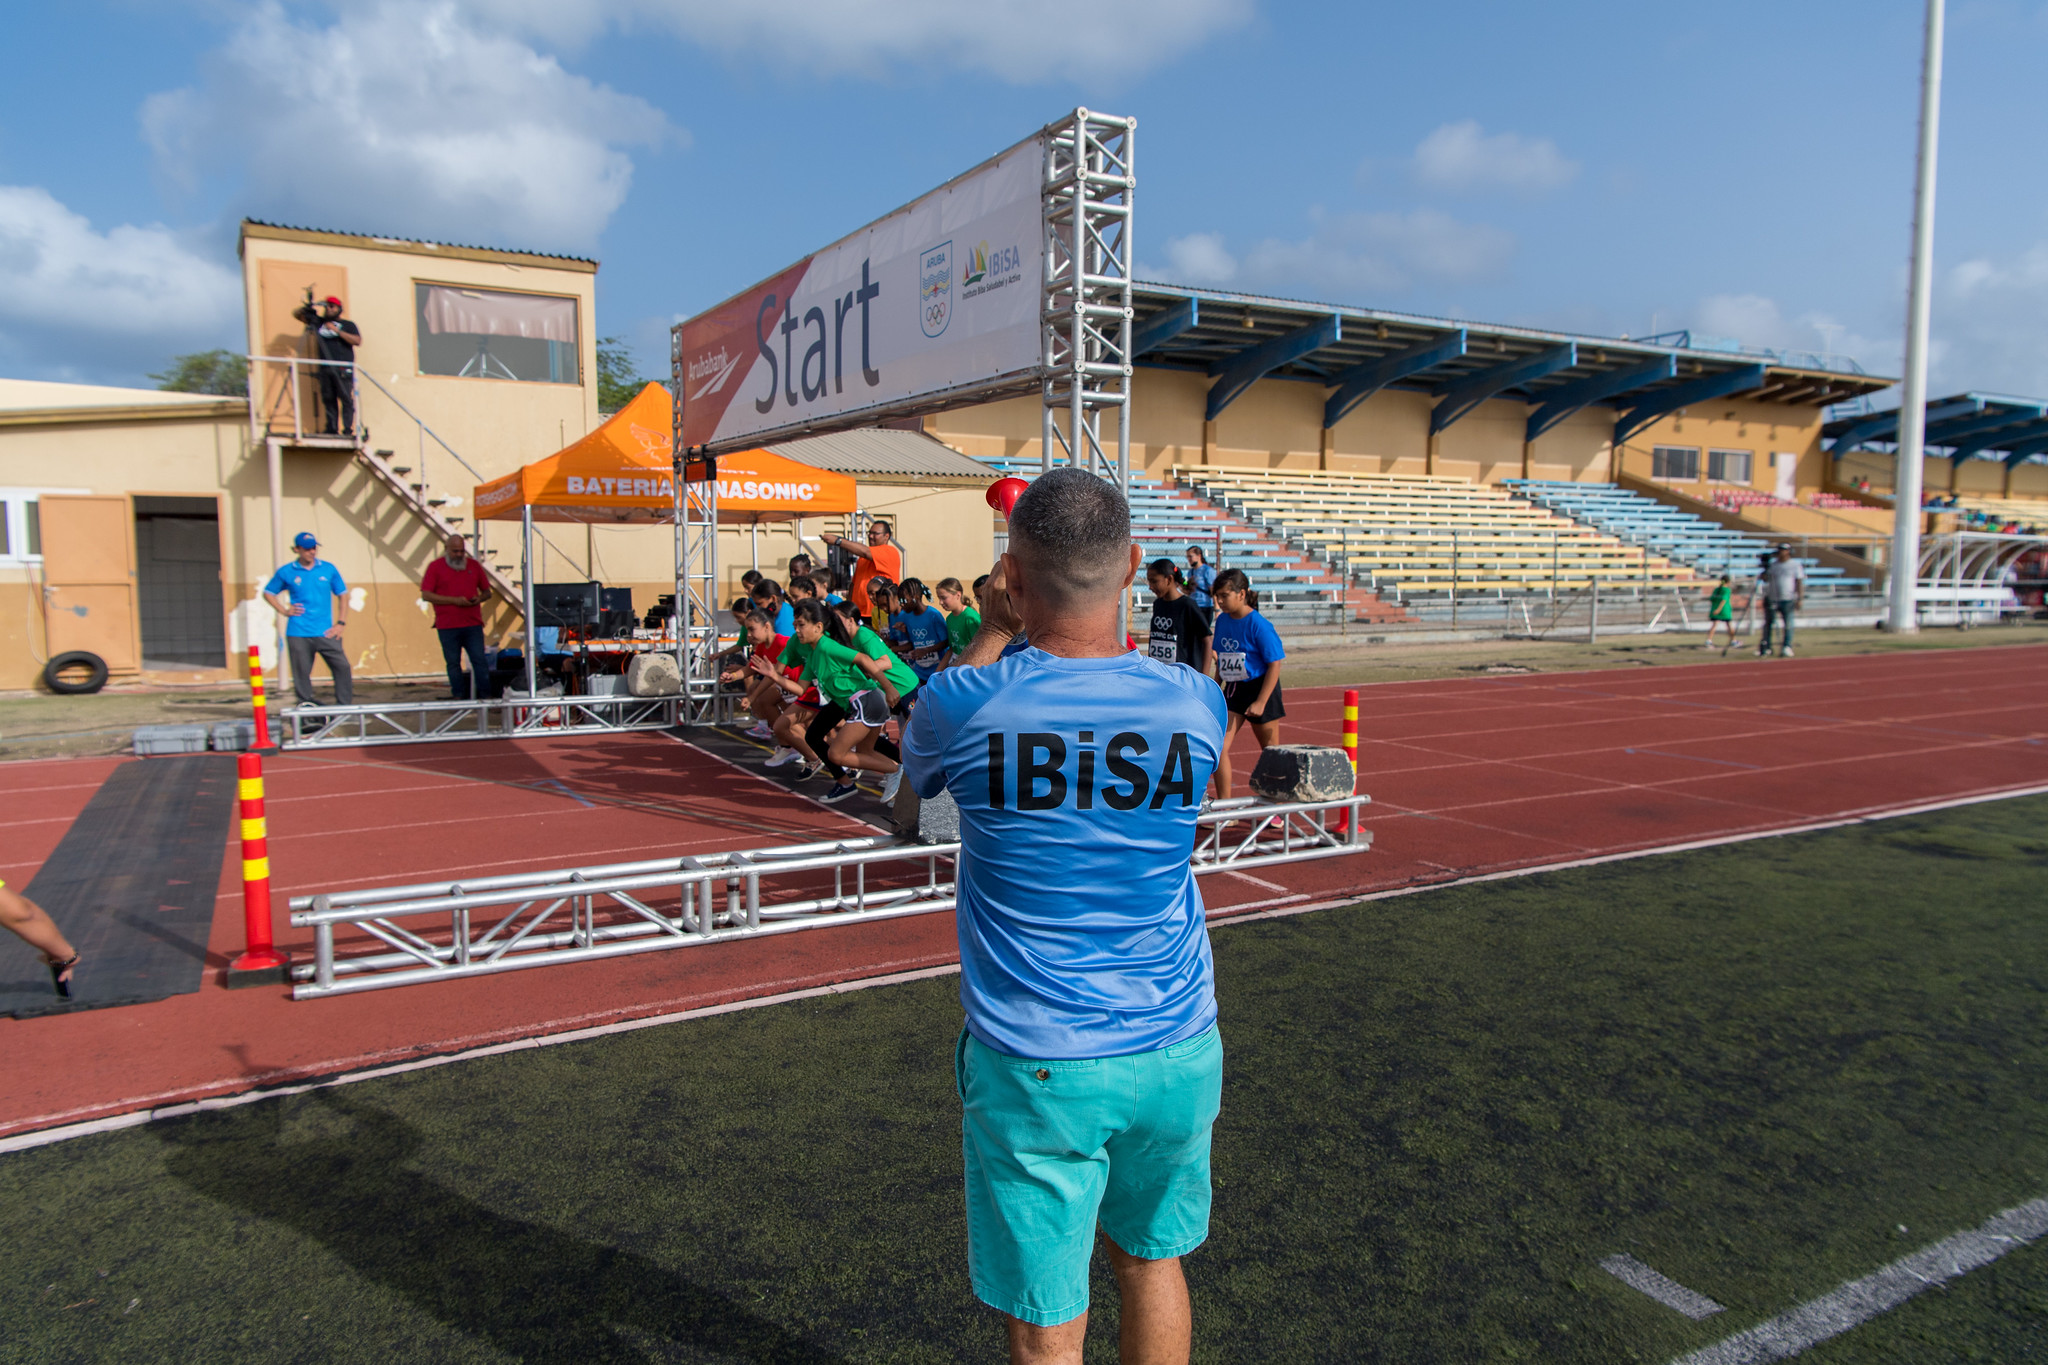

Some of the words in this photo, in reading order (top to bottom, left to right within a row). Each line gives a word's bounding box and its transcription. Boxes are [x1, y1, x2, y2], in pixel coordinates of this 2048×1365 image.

[926, 253, 945, 269] ARUBA
[989, 245, 1020, 278] IBiSA
[962, 287, 977, 300] Instituto
[1008, 273, 1021, 284] Activo
[756, 257, 879, 414] Start
[567, 476, 675, 498] BATERIA
[1151, 645, 1172, 659] 258
[1221, 658, 1242, 672] 244
[988, 730, 1194, 811] IBiSA
